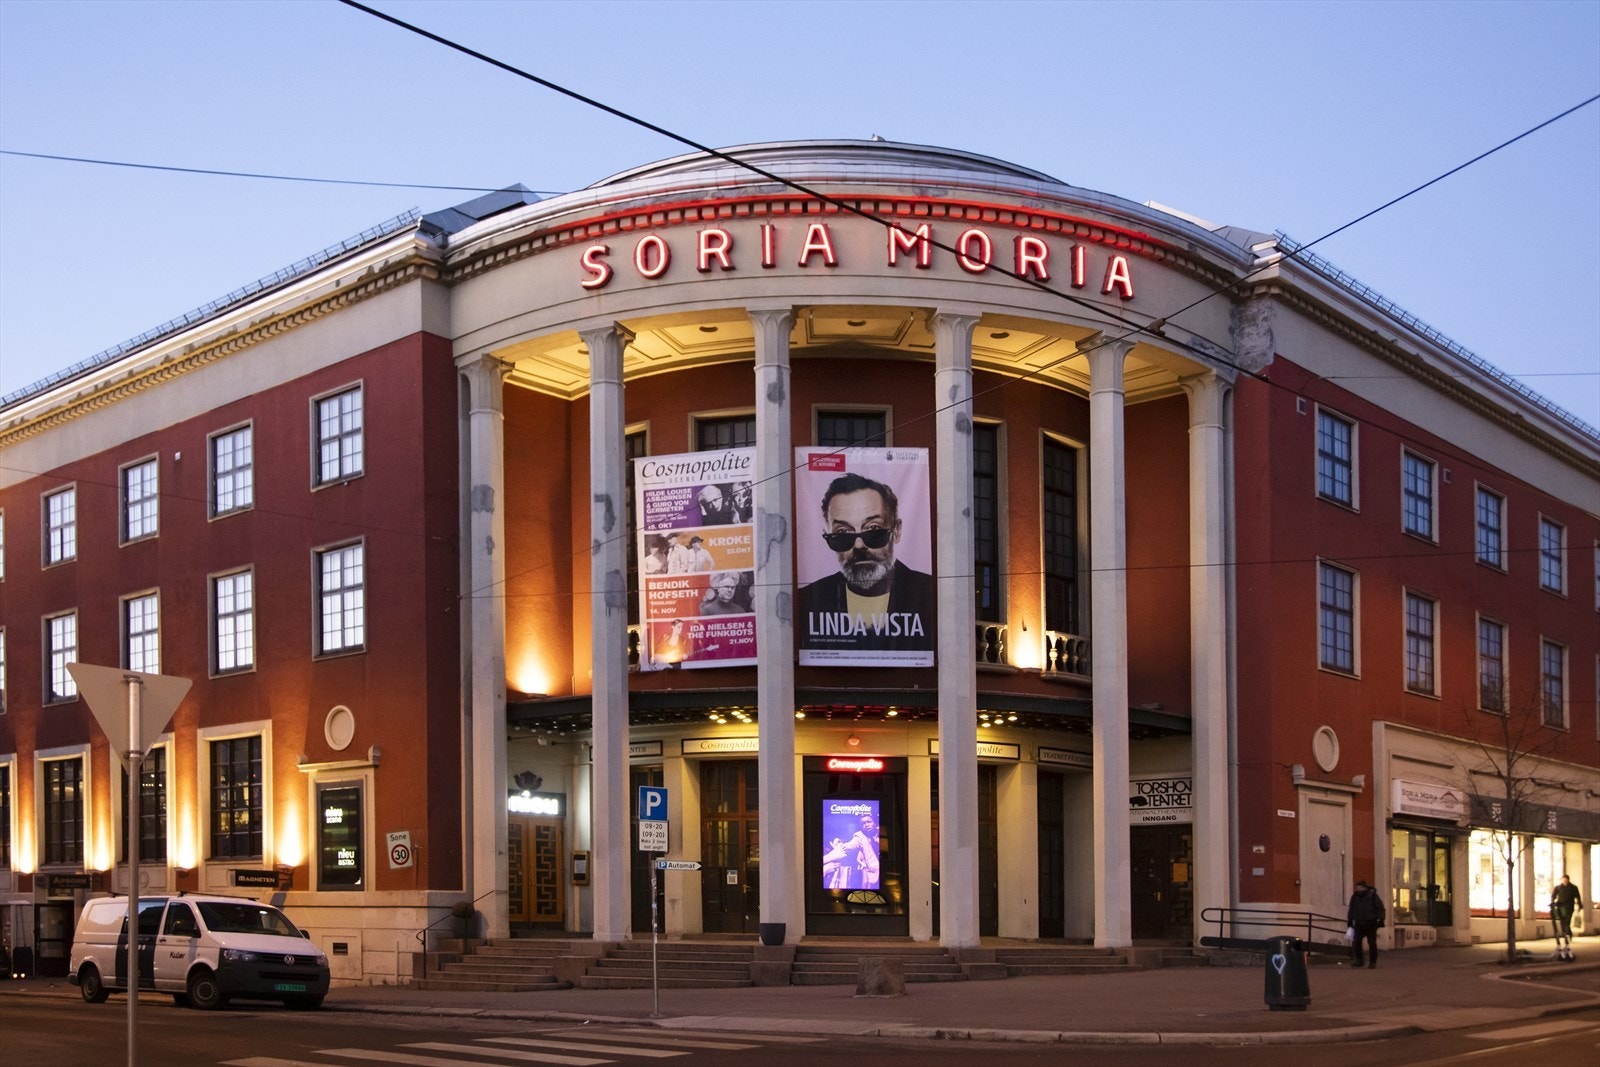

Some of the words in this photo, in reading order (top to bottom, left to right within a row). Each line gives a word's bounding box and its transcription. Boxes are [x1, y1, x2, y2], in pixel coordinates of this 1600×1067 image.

[580, 222, 837, 290] SORIA
[886, 221, 1134, 301] MORIA
[641, 451, 751, 481] Cosmopolite
[669, 476, 695, 484] SCENE
[707, 473, 729, 481] OSLO
[667, 488, 692, 496] LOUISE
[709, 535, 751, 547] KROKE
[648, 580, 690, 590] BENDIK
[648, 589, 699, 600] HOFSETH
[690, 624, 706, 632] IDA
[707, 621, 745, 631] NIELSEN
[746, 621, 754, 629] &
[809, 612, 868, 636] LINDA
[871, 612, 925, 637] VISTA
[687, 631, 704, 639] THE
[706, 628, 754, 638] FUNKBOTS
[729, 637, 754, 645] 21.NOV
[700, 739, 757, 751] Cosmopolite
[828, 758, 883, 772] Cosmopolite
[646, 791, 662, 817] P
[1146, 793, 1192, 807] TEATRET
[830, 804, 872, 815] Cosmopolite
[390, 834, 407, 842] Sone
[642, 831, 665, 839] (09-20)
[394, 849, 407, 861] 30
[238, 875, 275, 883] MAGNETEN
